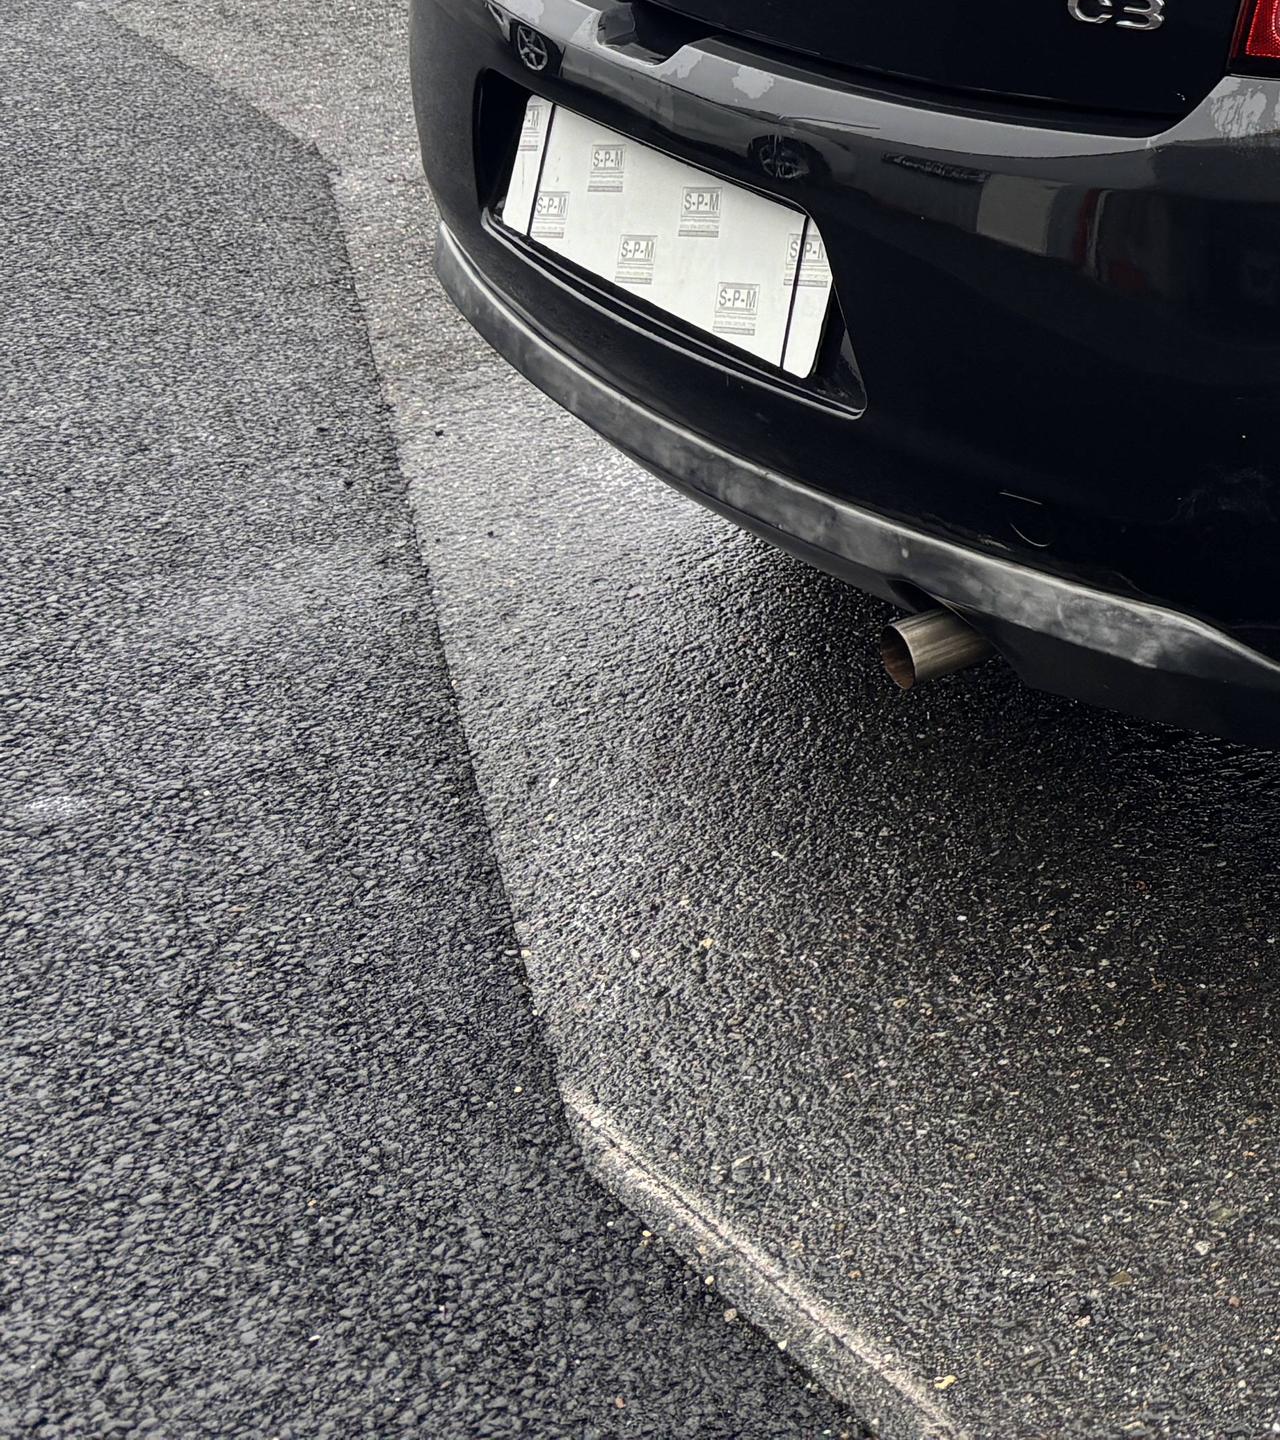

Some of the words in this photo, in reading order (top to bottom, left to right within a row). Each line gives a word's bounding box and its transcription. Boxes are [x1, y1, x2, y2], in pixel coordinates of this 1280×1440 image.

[684, 192, 720, 211] S-P-M
[621, 240, 655, 259] S-P-M
[719, 289, 757, 309] S-P-M
